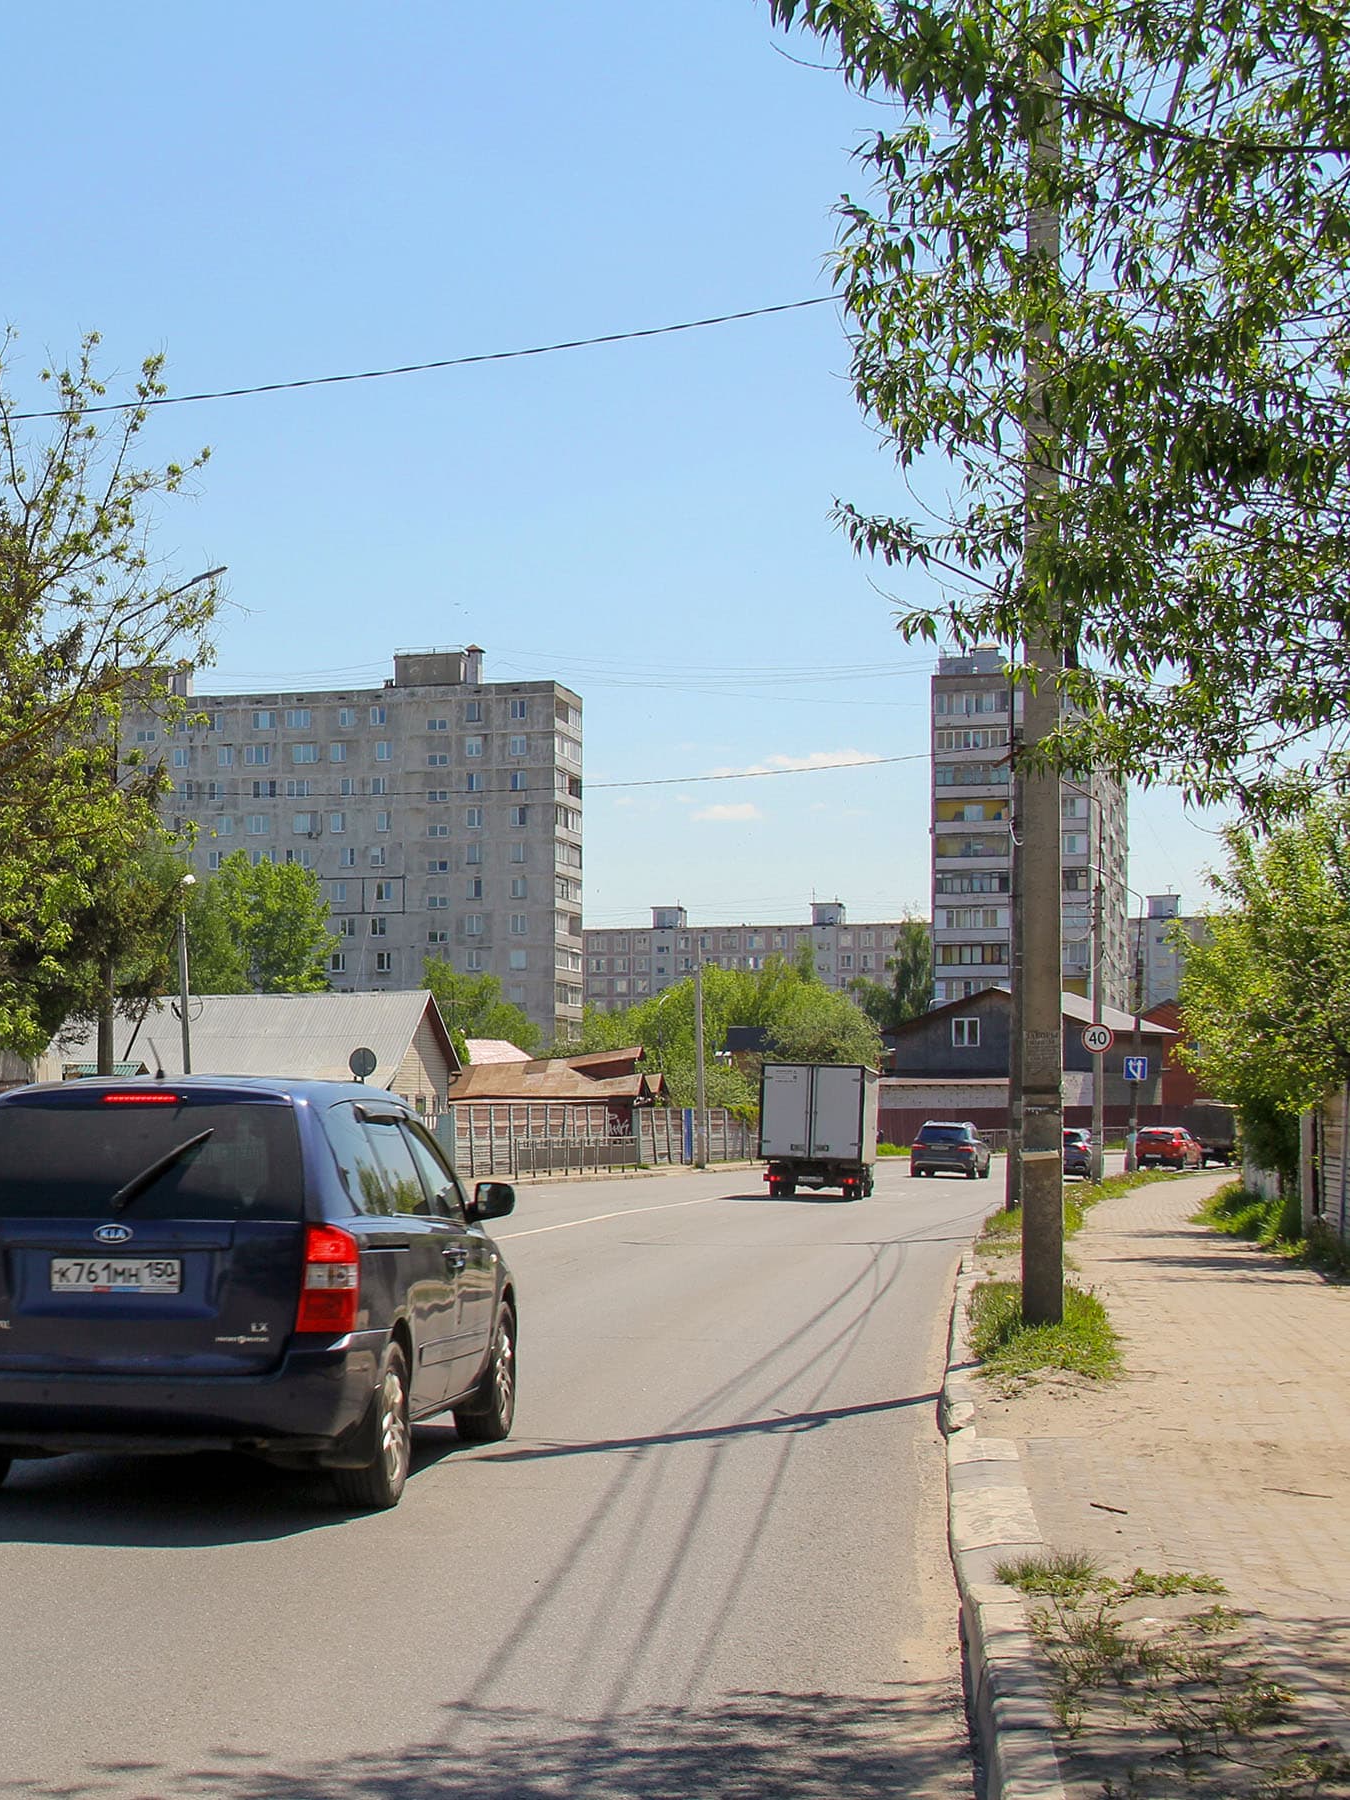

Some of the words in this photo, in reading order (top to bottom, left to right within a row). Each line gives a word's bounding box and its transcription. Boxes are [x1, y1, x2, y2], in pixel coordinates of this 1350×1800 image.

[1088, 1031, 1107, 1045] 40
[99, 1228, 126, 1240] KIA
[144, 1262, 174, 1278] 150
